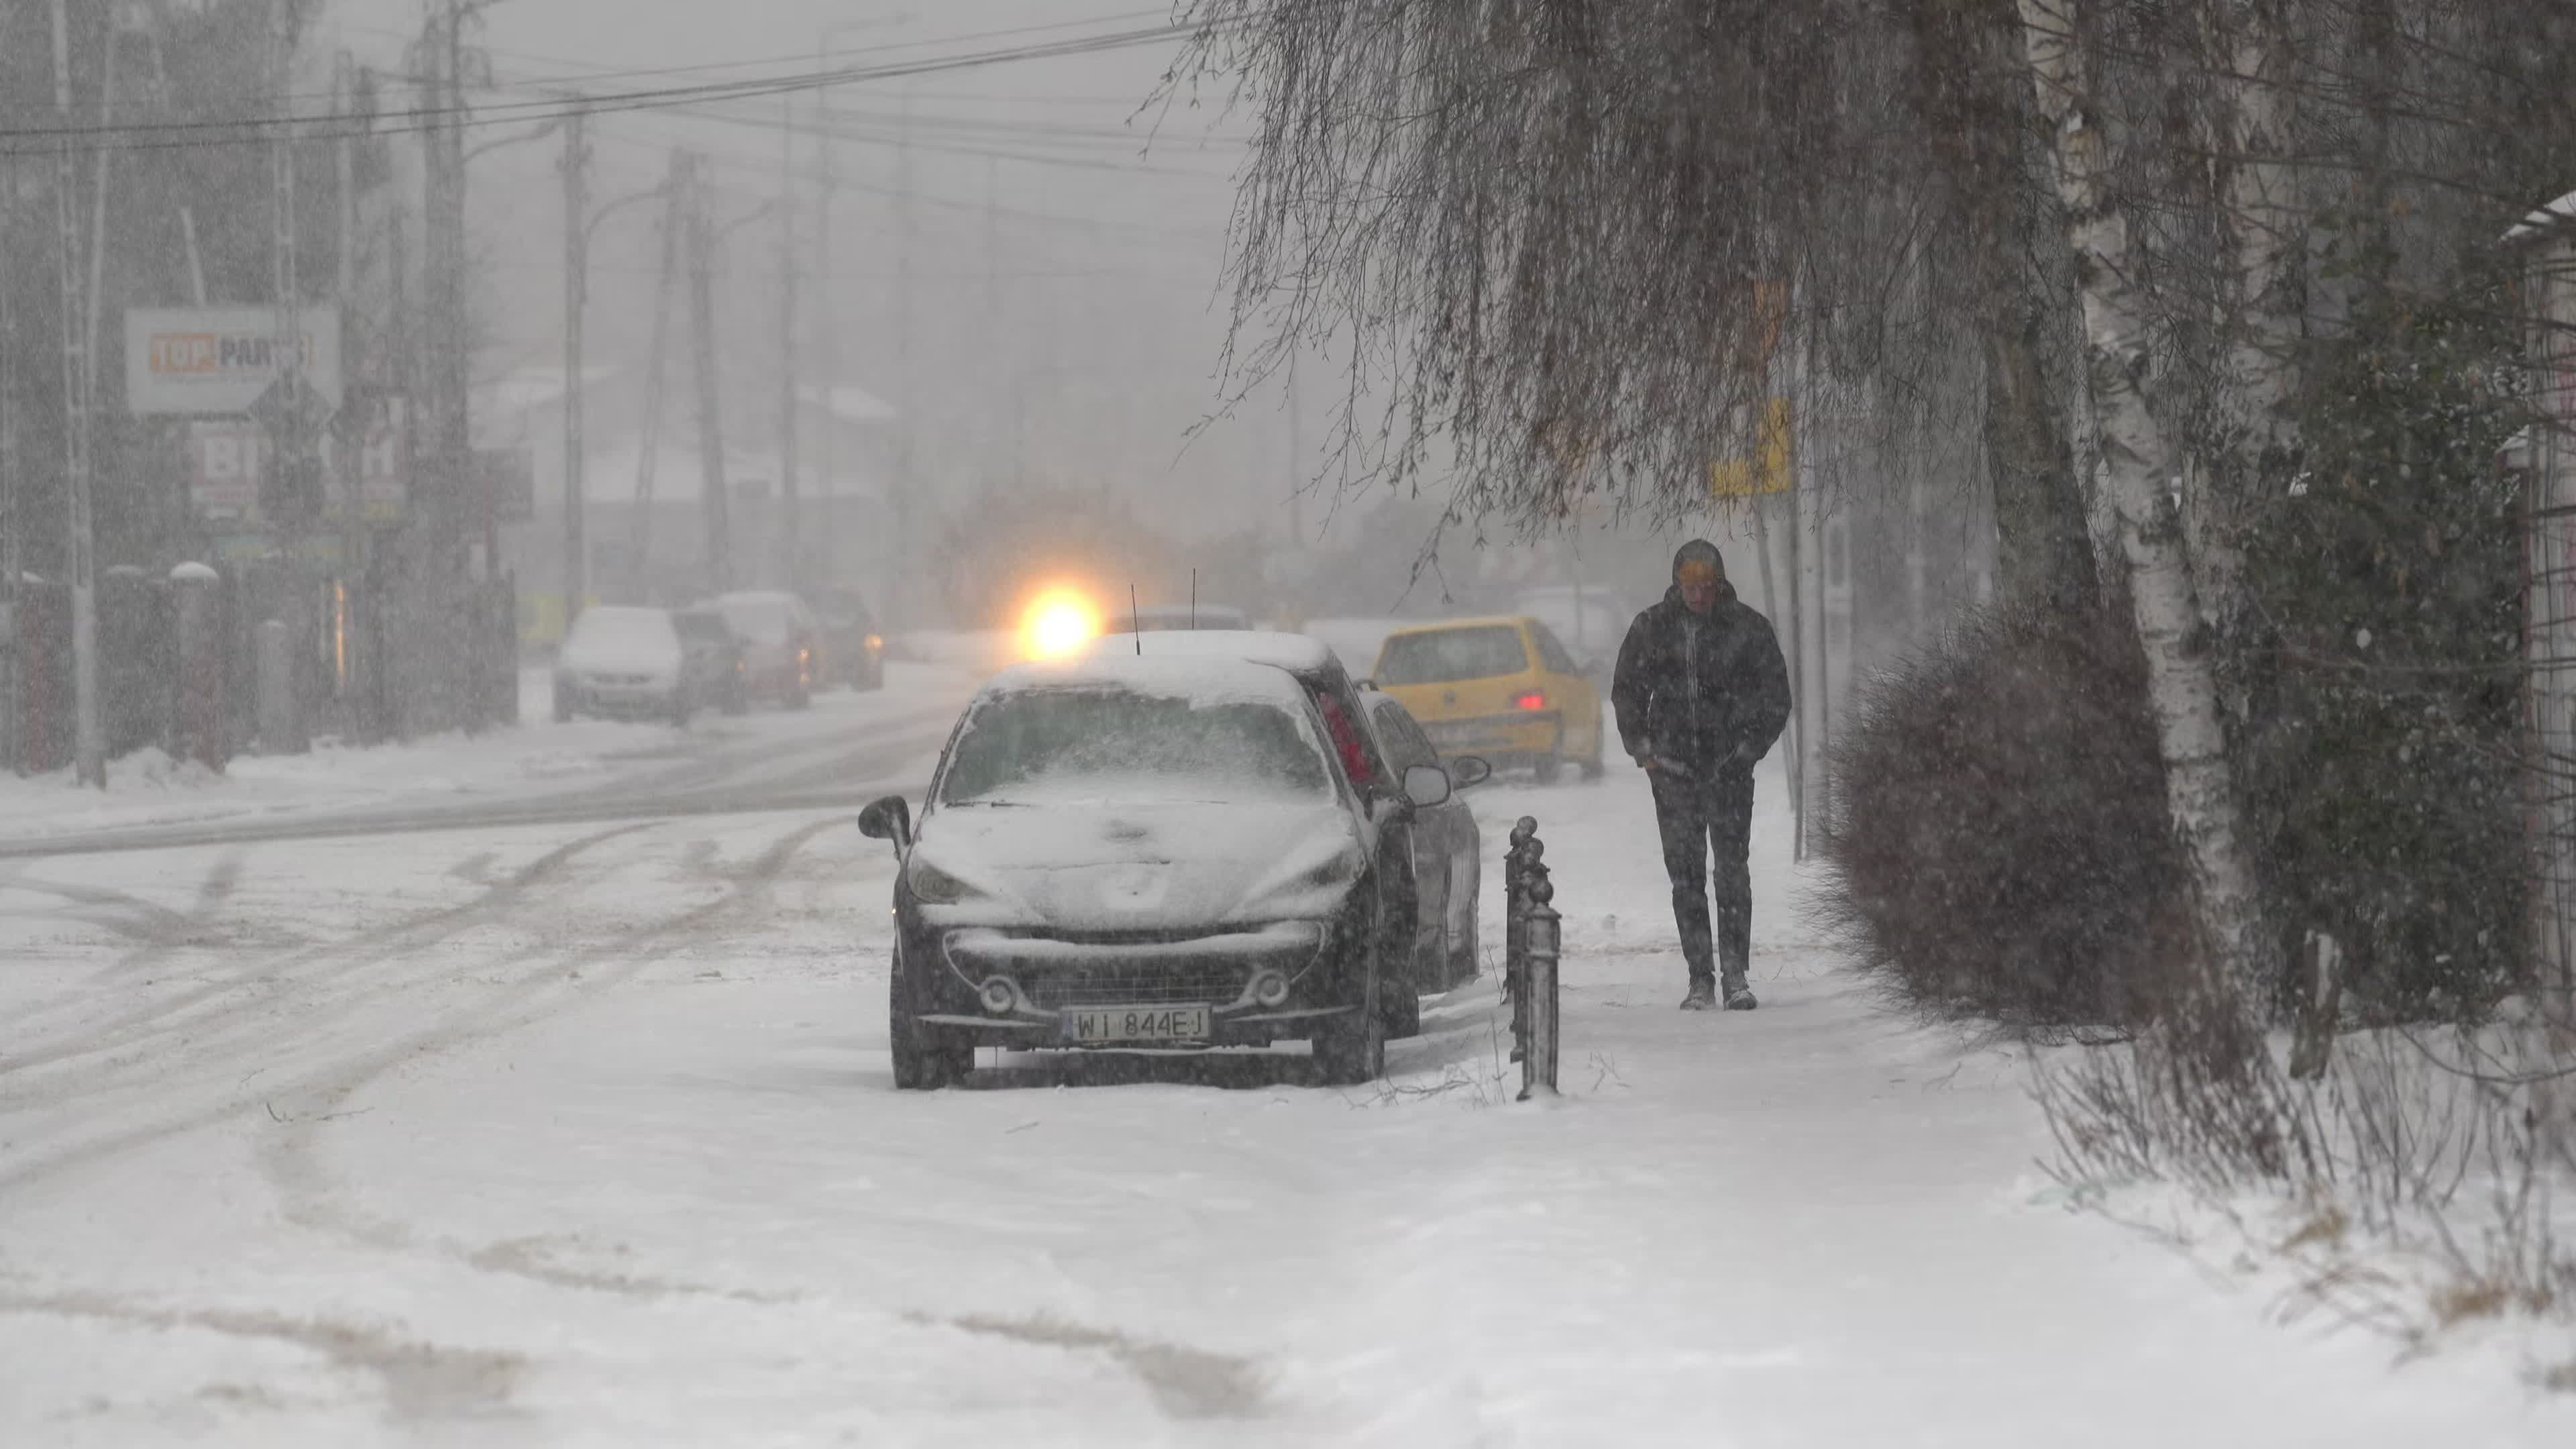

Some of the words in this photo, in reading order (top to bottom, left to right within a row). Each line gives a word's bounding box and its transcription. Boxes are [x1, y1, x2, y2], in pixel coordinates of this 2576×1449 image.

[152, 338, 211, 366] TOP
[1078, 1014, 1109, 1038] WI
[1125, 1011, 1201, 1036] 844EJ
